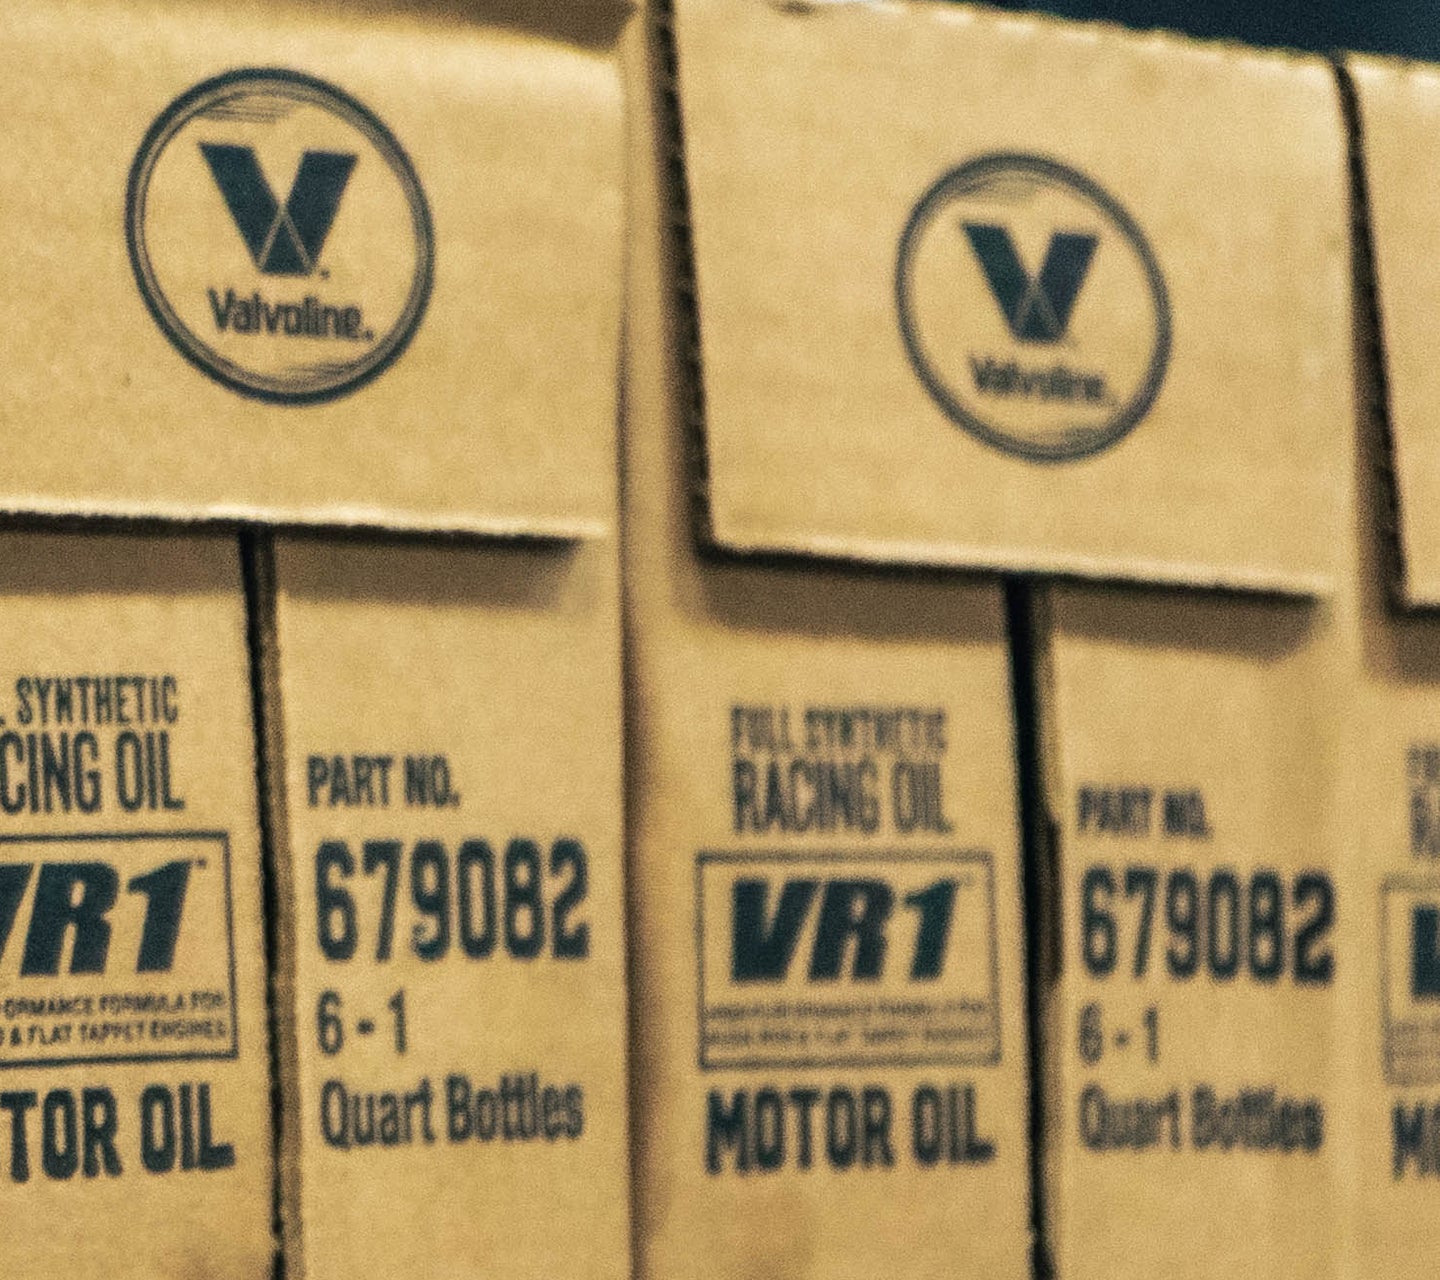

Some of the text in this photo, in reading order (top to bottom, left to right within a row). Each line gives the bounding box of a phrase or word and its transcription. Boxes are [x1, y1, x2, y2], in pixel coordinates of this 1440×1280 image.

[15, 672, 179, 725] SYNTHETIC
[115, 729, 185, 811] OIL
[306, 754, 461, 808] PART NO.
[315, 837, 591, 963] 679082
[1081, 865, 1336, 988] 679082
[139, 1081, 237, 1173] OIL
[319, 1070, 586, 1152] Quart Bottles
[705, 1080, 997, 1177] MOTOR OIL
